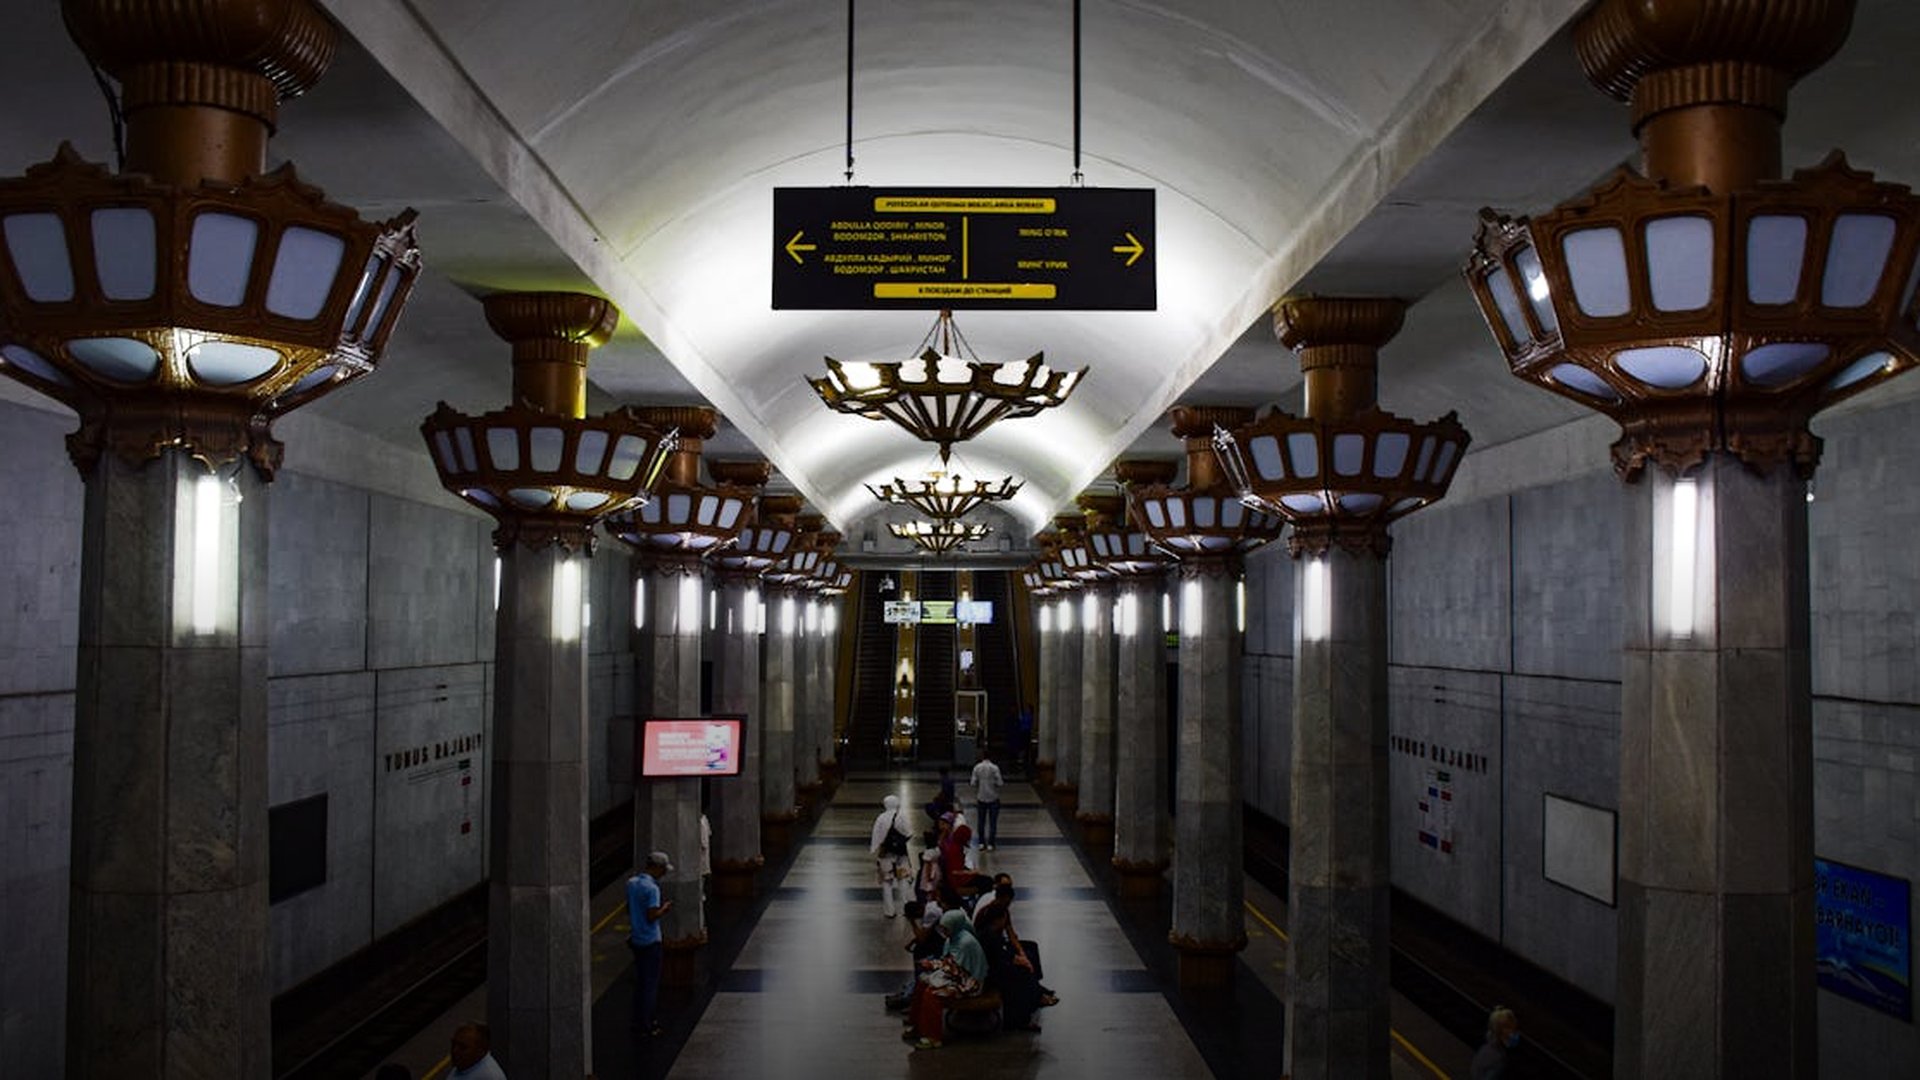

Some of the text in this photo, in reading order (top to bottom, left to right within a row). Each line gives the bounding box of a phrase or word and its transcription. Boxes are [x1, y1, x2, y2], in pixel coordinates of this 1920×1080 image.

[831, 221, 871, 230] ABDULLA
[891, 232, 946, 241] SHAHRISTON
[824, 254, 865, 263] АБДУЛЛА
